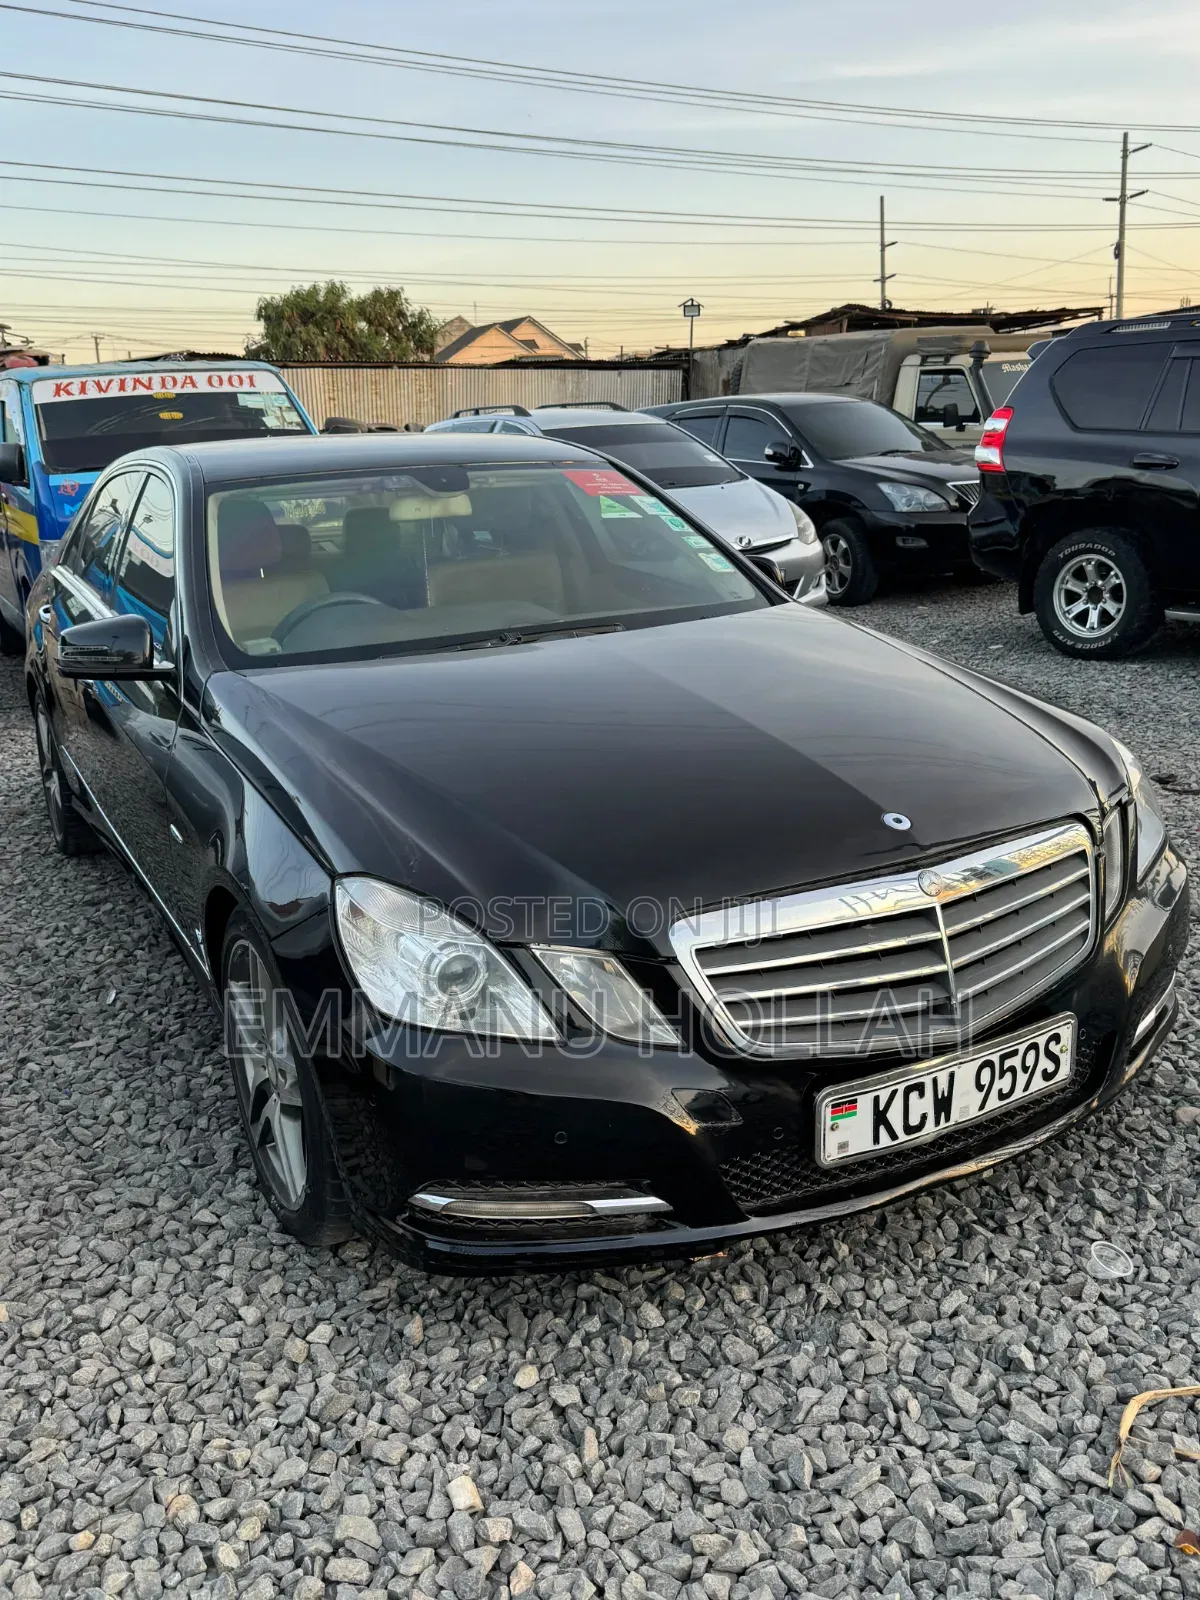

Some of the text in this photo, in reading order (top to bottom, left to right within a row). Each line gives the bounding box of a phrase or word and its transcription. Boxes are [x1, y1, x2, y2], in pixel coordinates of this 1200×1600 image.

[53, 375, 199, 398] KIVINDA
[207, 374, 257, 389] 001
[1058, 543, 1116, 559] TOURADOR
[1075, 637, 1112, 650] FORCE
[872, 1032, 1062, 1146] KCW 959S
